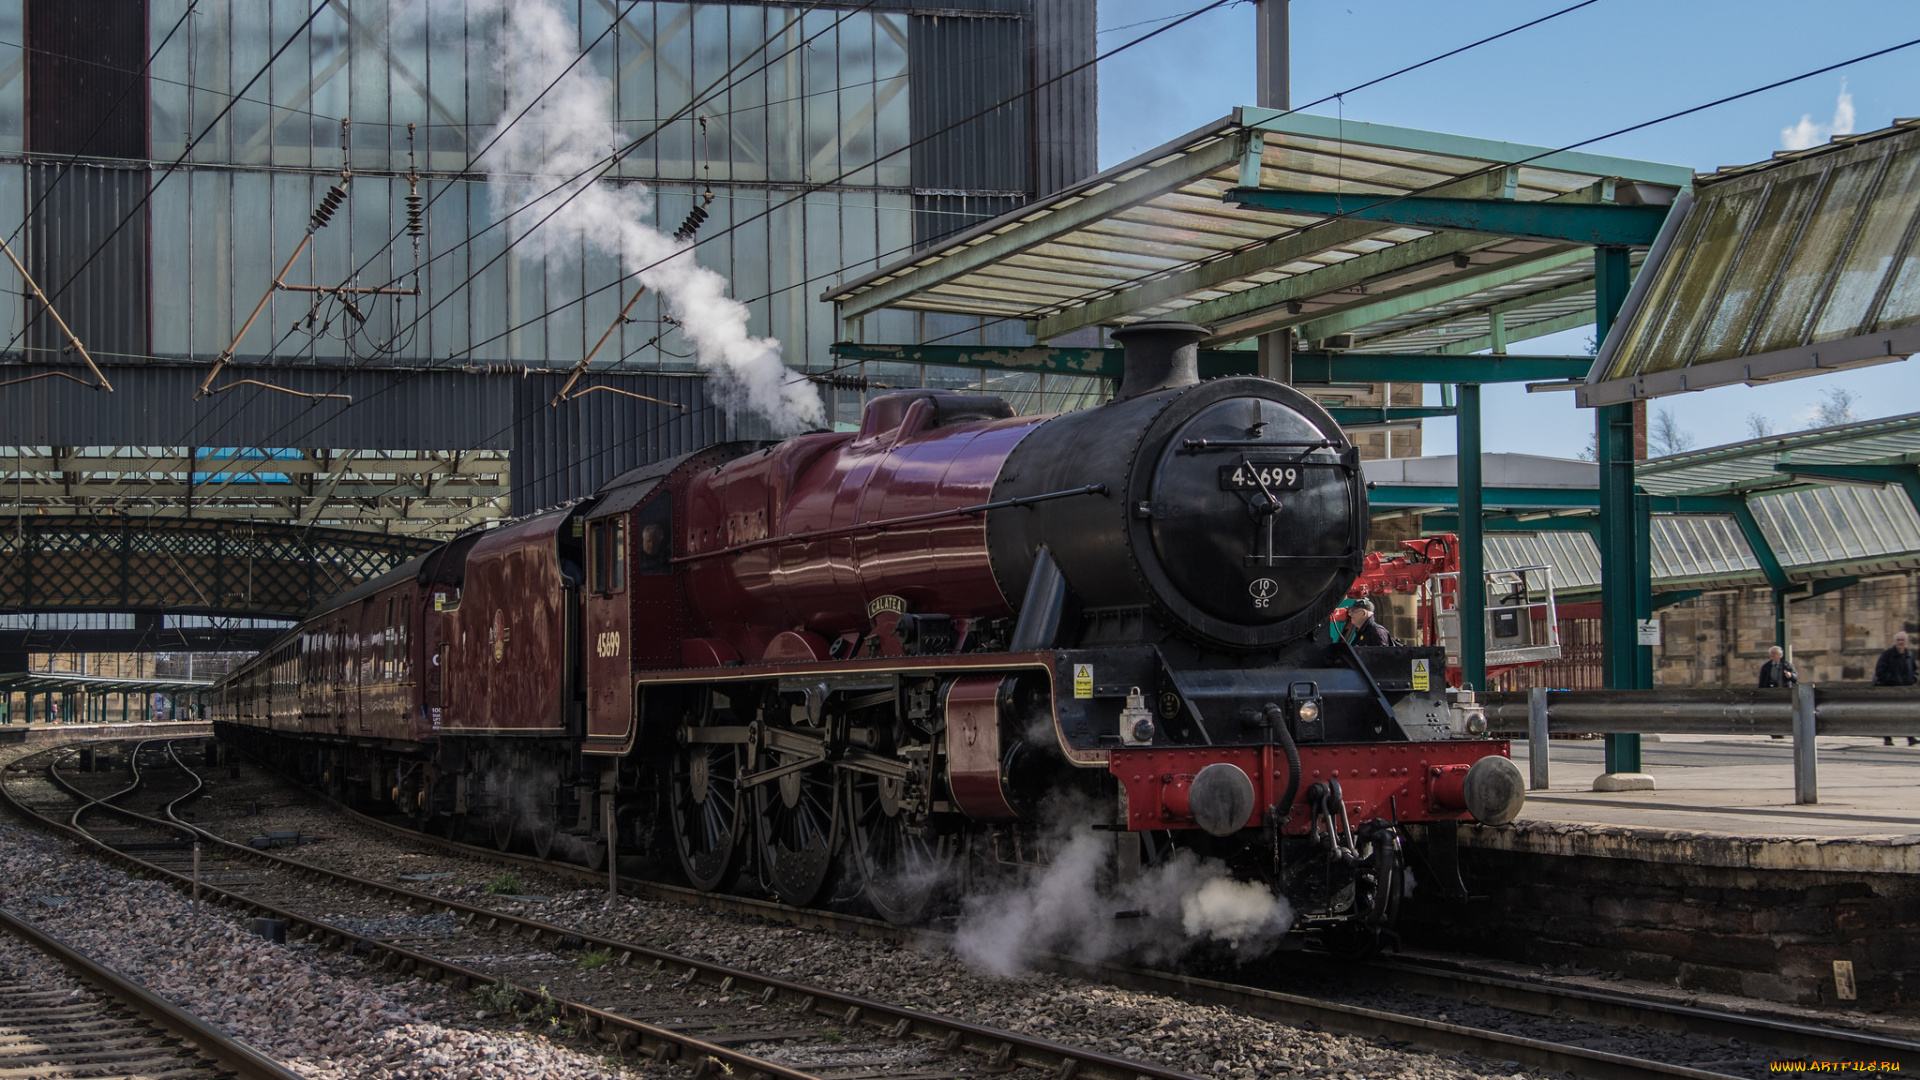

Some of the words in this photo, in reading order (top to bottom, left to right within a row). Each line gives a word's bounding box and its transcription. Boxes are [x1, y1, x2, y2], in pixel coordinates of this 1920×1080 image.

[1260, 580, 1270, 590] 10
[1260, 589, 1267, 597] A
[871, 597, 902, 613] GALATEA
[1255, 598, 1270, 608] SC
[596, 631, 620, 658] 45699
